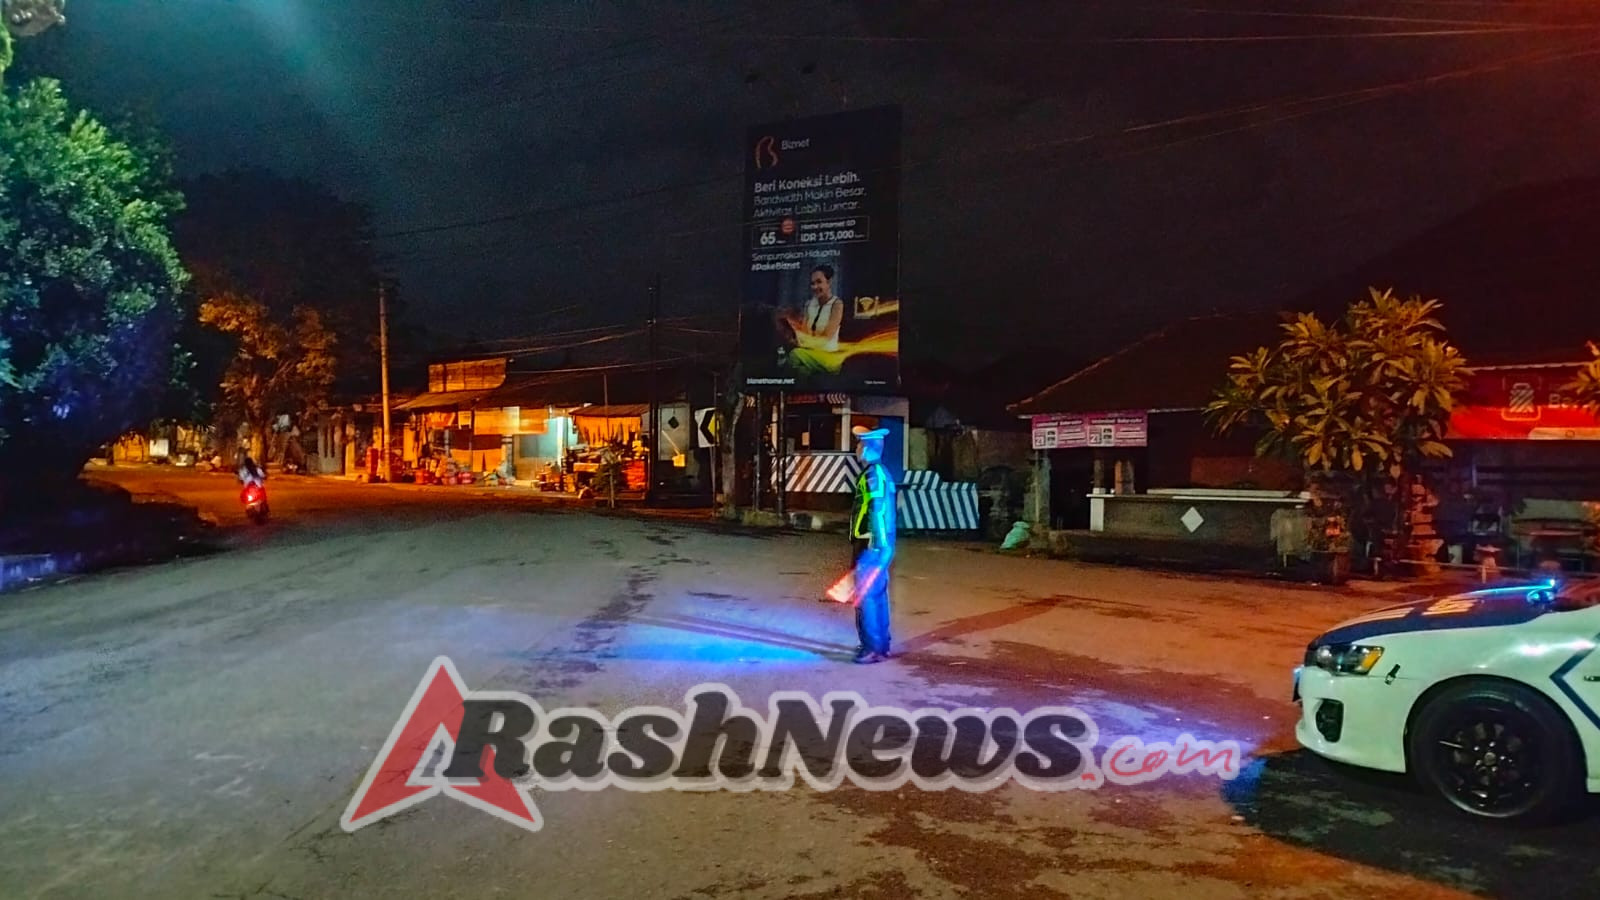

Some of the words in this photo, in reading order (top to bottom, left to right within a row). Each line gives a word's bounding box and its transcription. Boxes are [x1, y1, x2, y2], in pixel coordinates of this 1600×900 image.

[781, 138, 810, 150] Biznet
[754, 181, 776, 193] Beri
[778, 175, 823, 190] Koneksi
[825, 171, 860, 185] Lebih.
[753, 191, 804, 206] Bandwidth
[804, 189, 834, 201] Makin
[753, 206, 793, 218] Aktivitas
[760, 232, 776, 245] 65
[800, 232, 816, 242] IDR
[818, 230, 854, 242] 175,000
[752, 250, 804, 262] Sempurnakan
